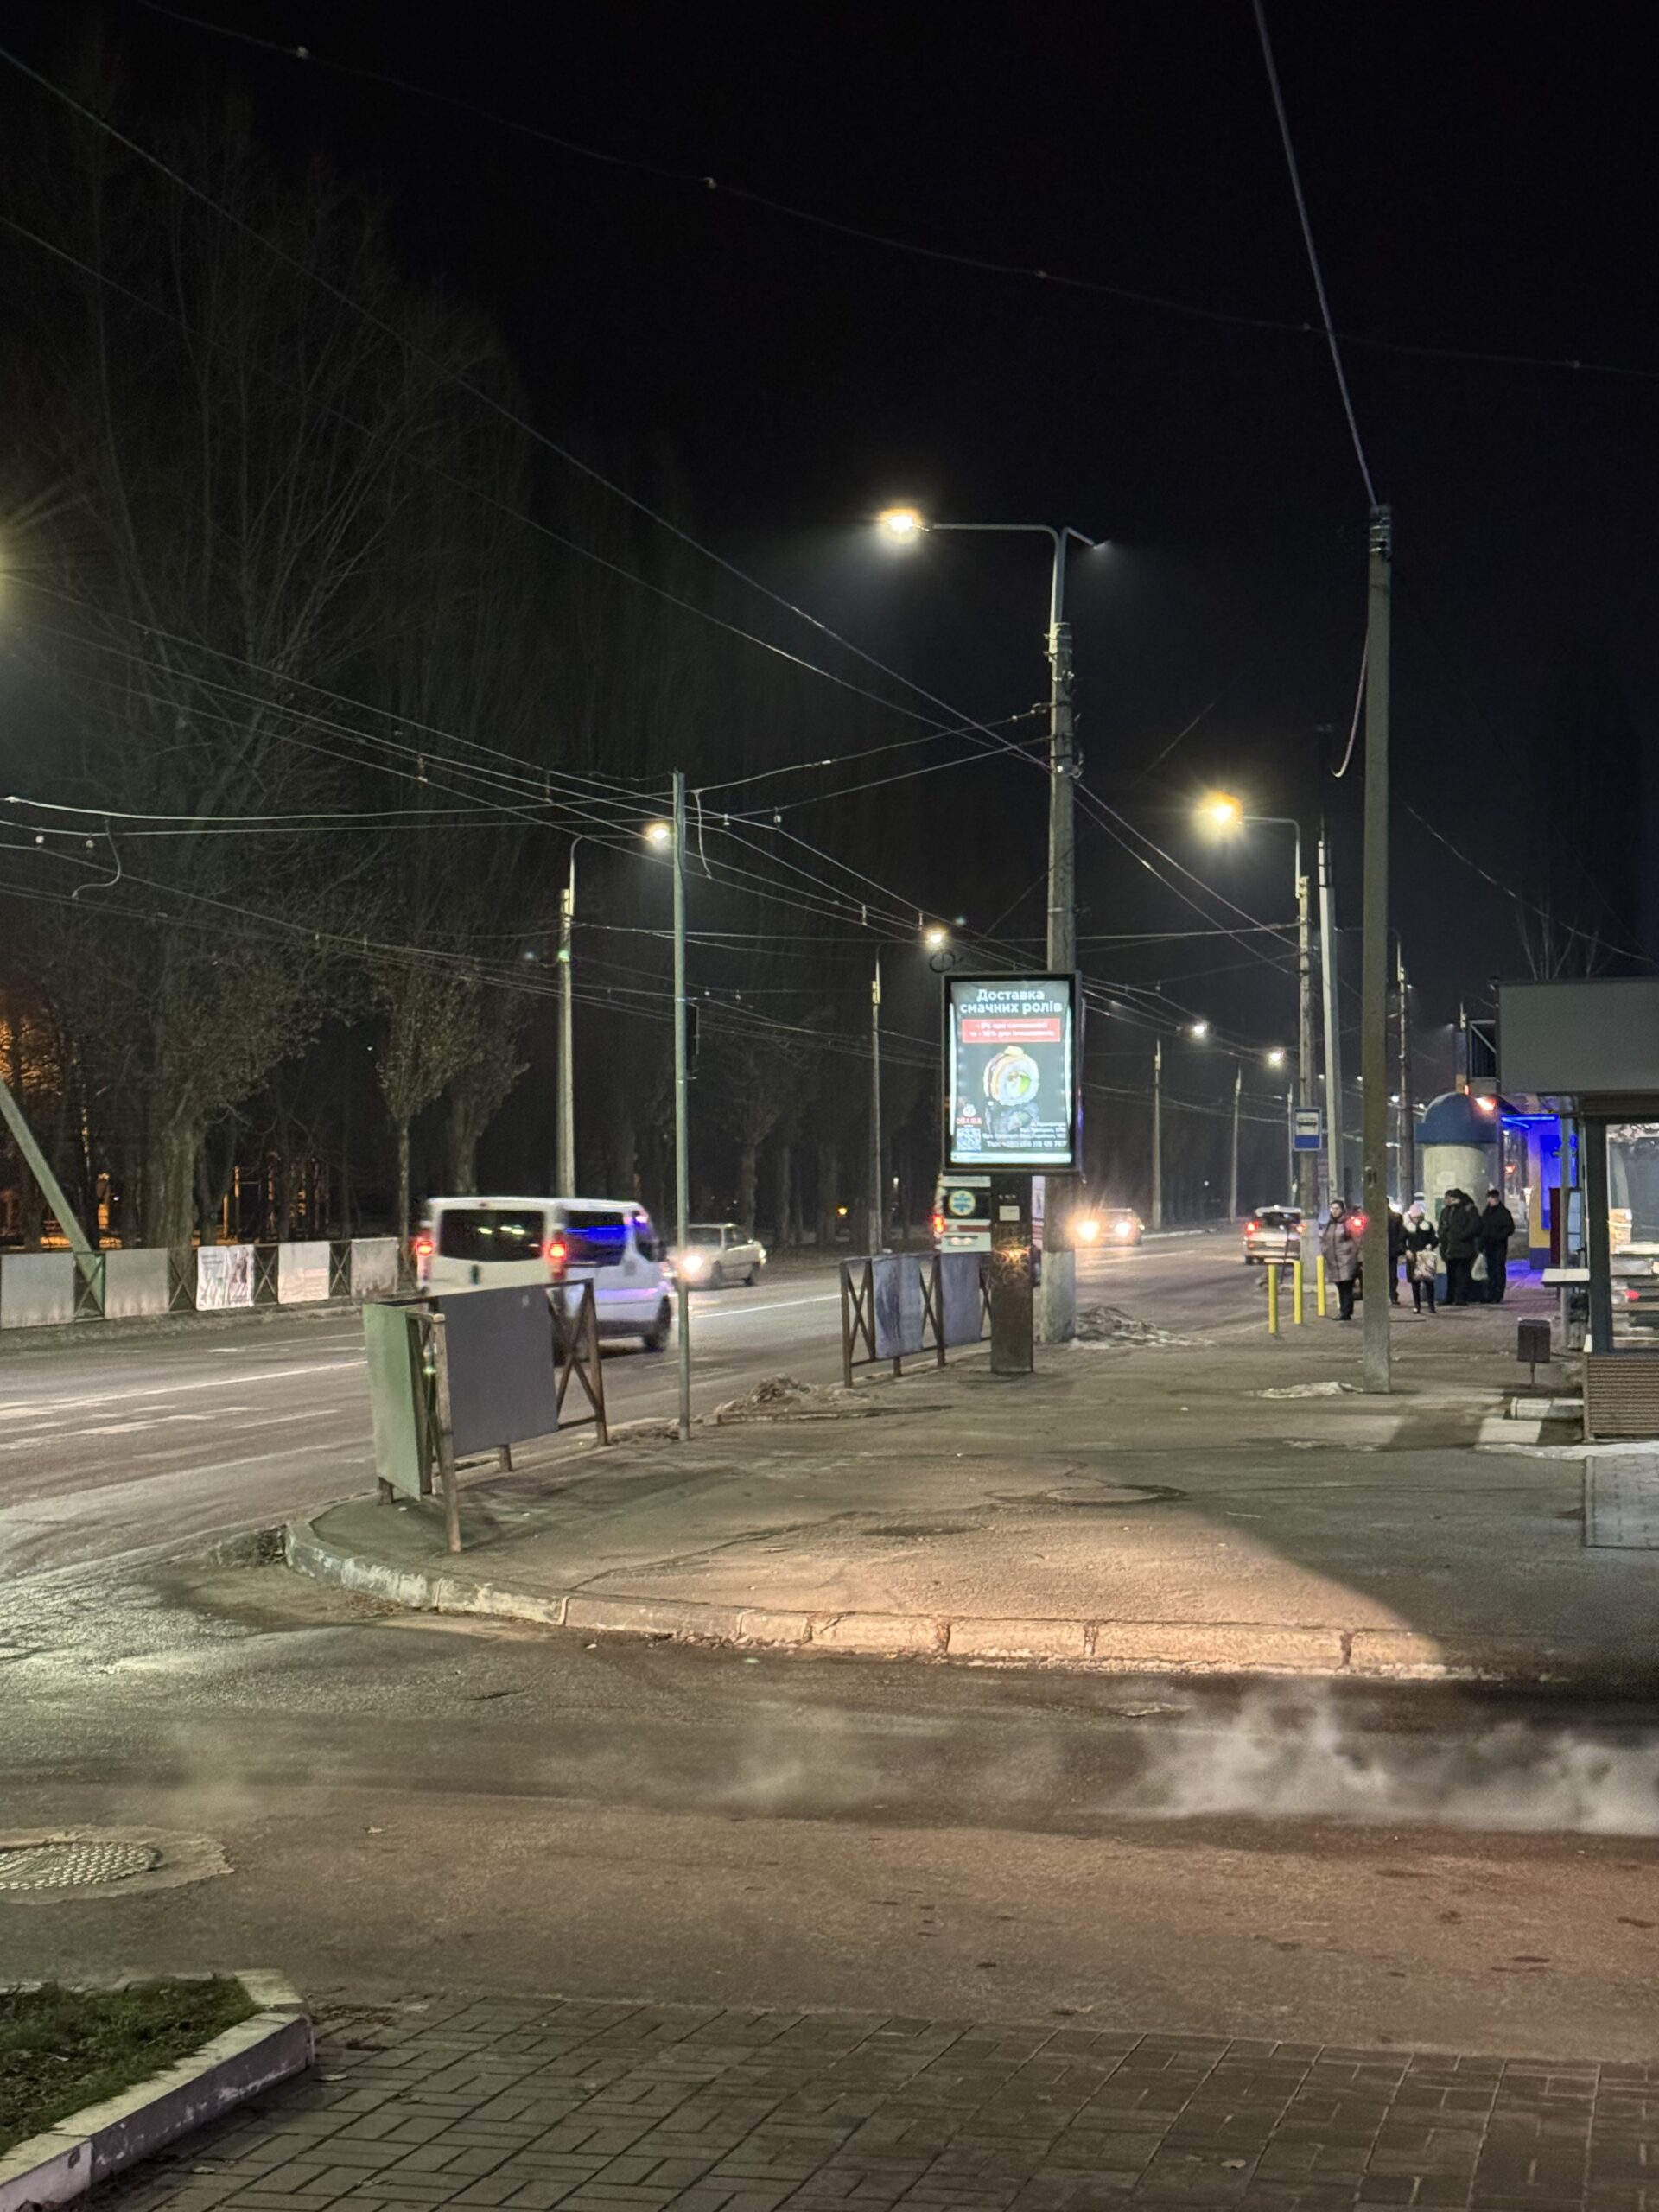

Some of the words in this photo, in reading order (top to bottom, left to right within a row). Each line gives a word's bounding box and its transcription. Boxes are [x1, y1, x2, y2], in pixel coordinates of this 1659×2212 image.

[976, 988, 1045, 1002] Доставка
[960, 1002, 1019, 1014] смачних
[1022, 1000, 1063, 1015] ролів
